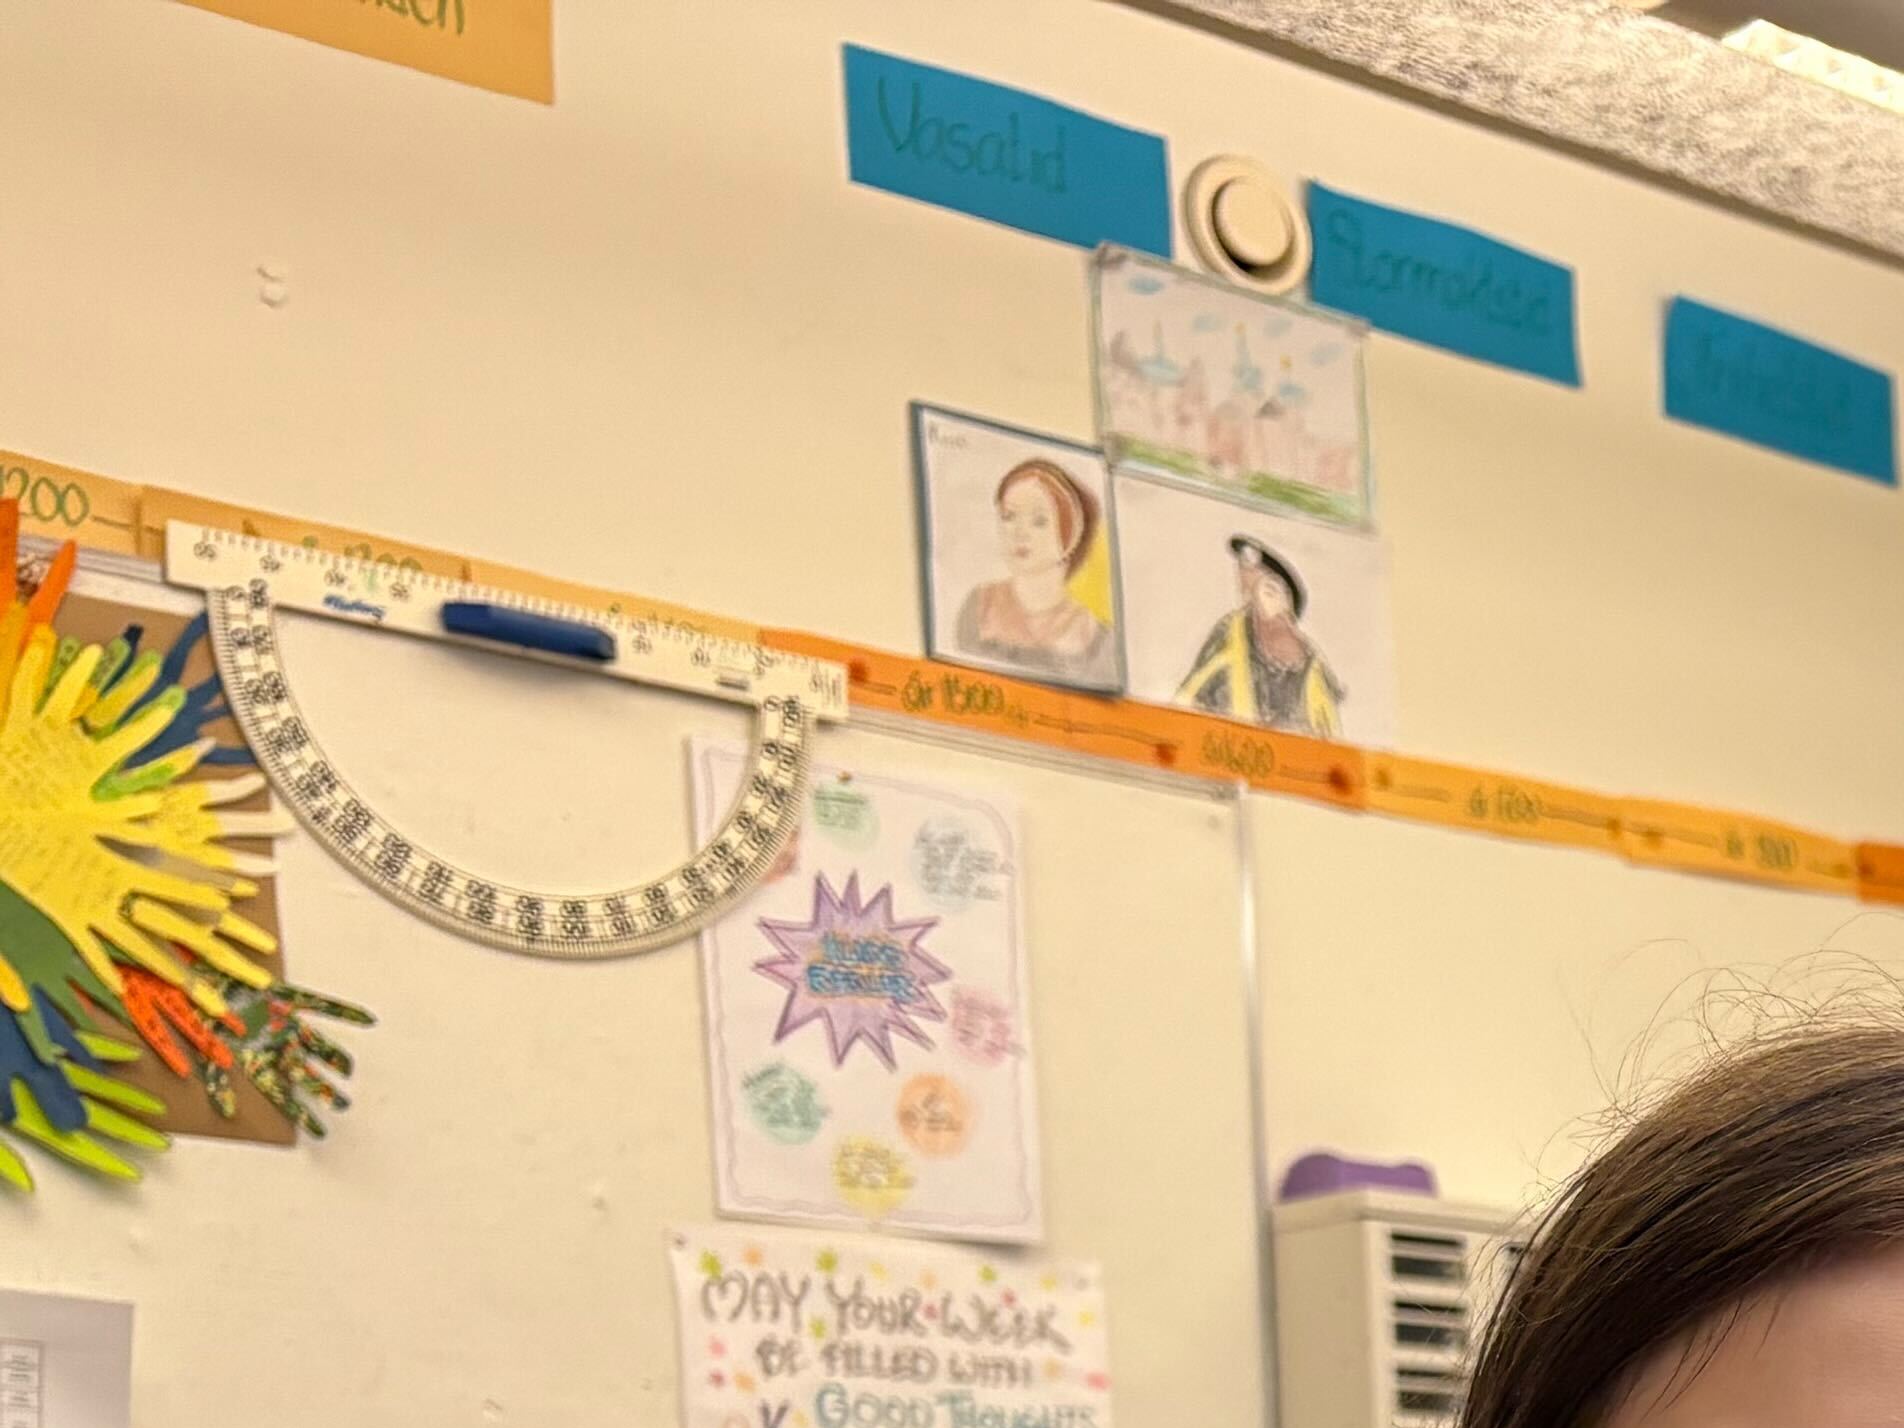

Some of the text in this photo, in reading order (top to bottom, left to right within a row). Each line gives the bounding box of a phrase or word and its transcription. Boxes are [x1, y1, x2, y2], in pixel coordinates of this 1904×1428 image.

[700, 1268, 811, 1334] MAY
[824, 1276, 931, 1338] YOUR
[820, 1338, 939, 1384] FILLED
[947, 1350, 1035, 1387] WITH
